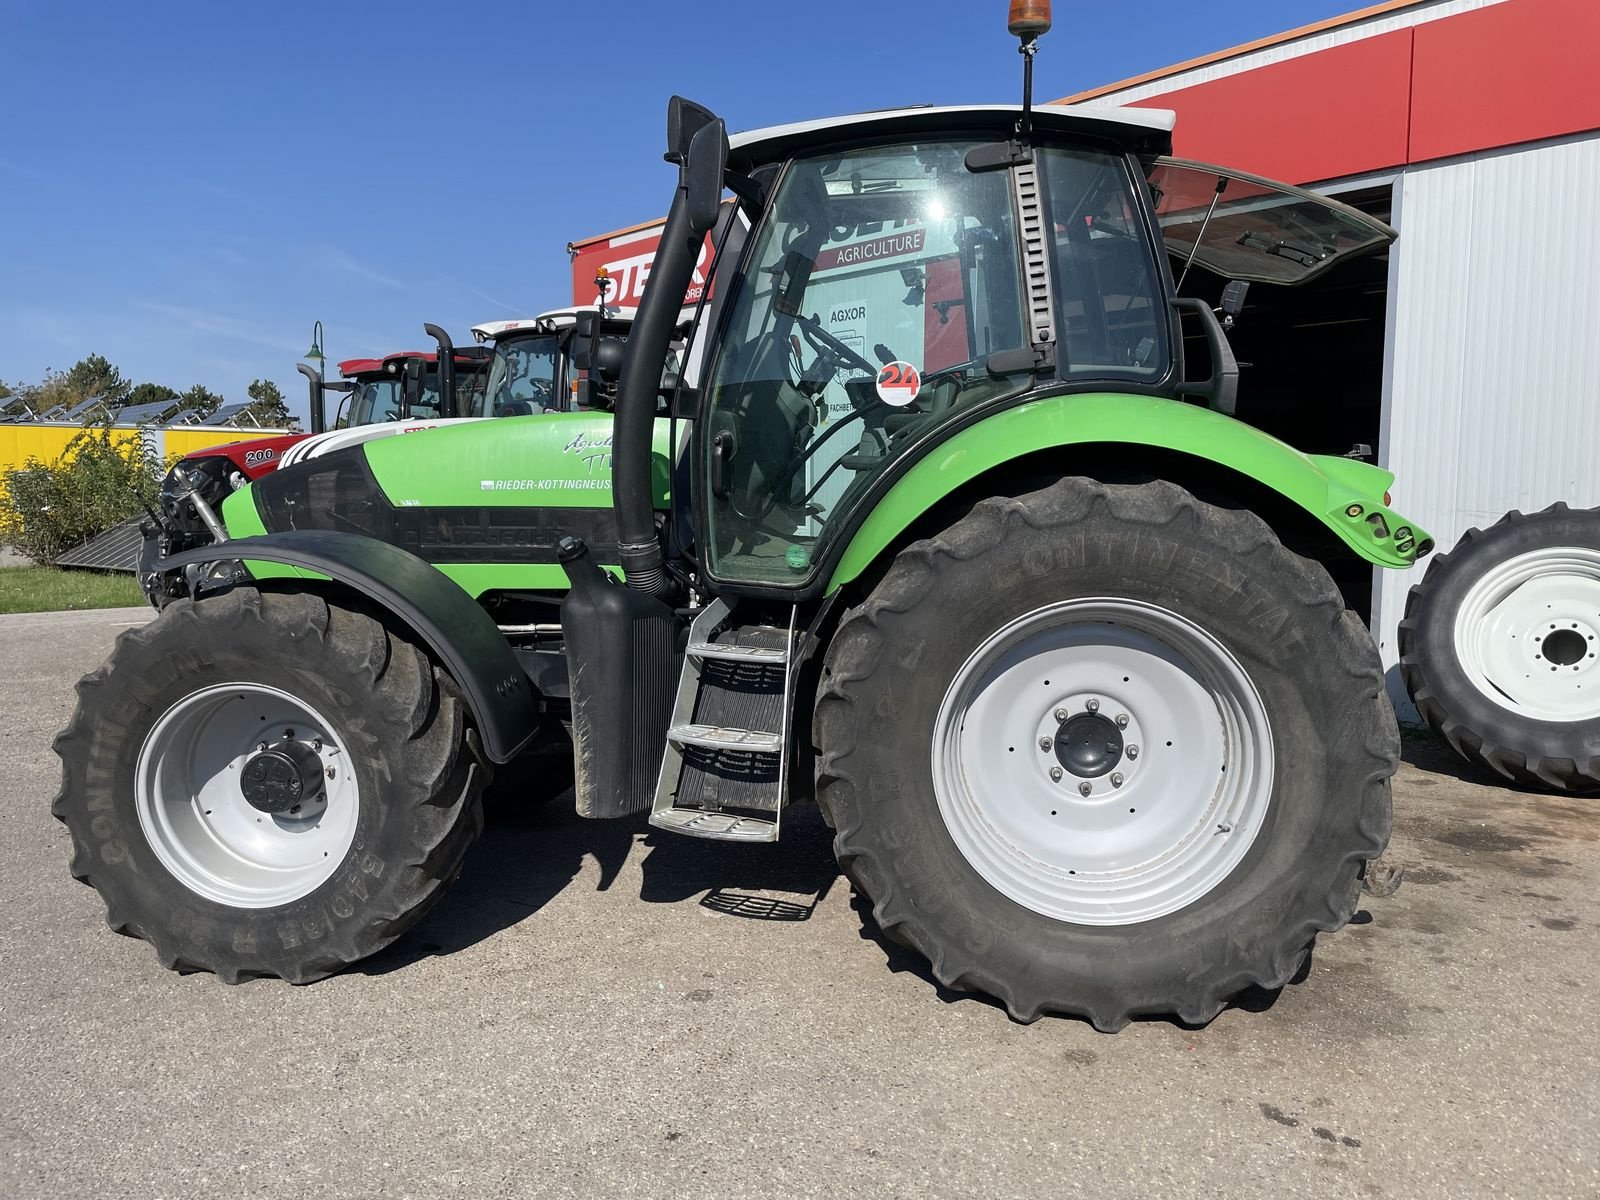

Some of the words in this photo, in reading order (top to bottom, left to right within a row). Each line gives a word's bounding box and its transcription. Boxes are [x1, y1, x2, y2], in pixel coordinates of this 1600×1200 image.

[836, 233, 921, 264] AGRICULTURE
[593, 243, 707, 306] STER
[830, 306, 866, 323] AGXOR
[880, 365, 919, 396] 24
[829, 403, 852, 412] FACHBET
[245, 449, 273, 464] 200
[495, 479, 613, 490] RIEDER-KOTTINGNEUS
